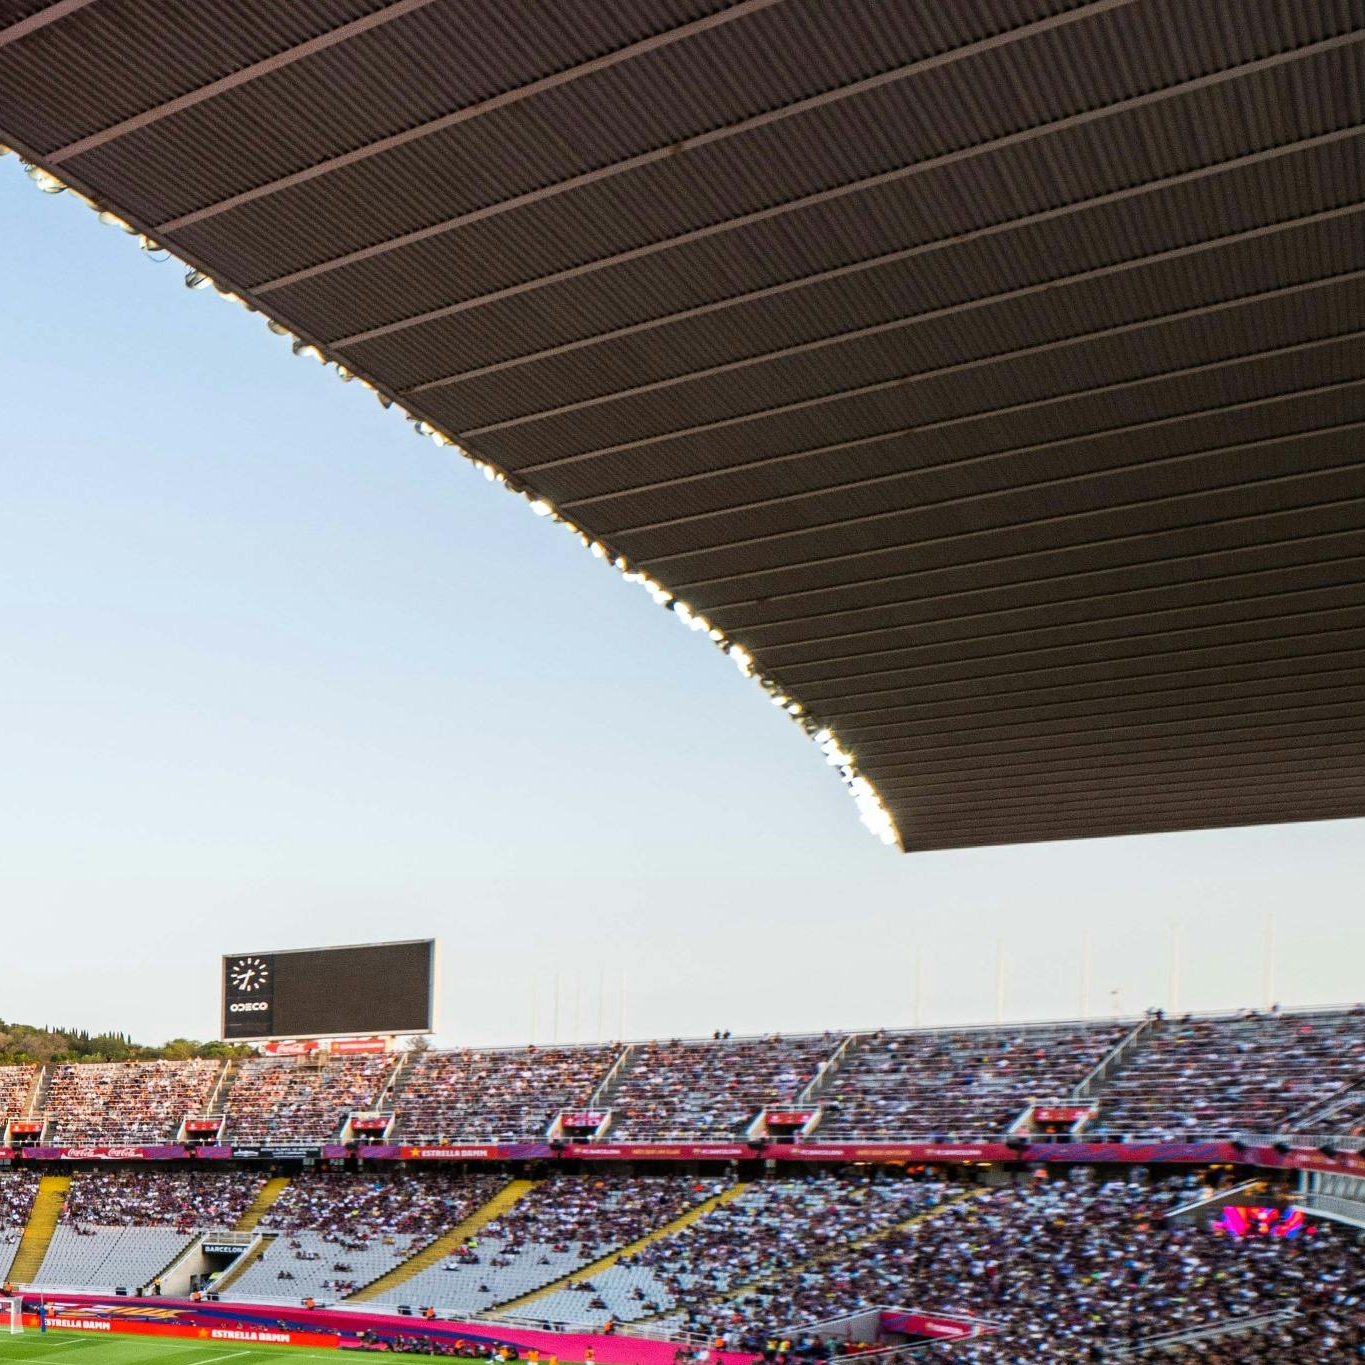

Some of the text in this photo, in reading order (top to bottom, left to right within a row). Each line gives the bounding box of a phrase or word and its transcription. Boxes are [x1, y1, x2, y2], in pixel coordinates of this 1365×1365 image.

[230, 1002, 268, 1013] ODECO
[421, 1149, 459, 1157] ESTRELLA
[205, 1246, 247, 1254] BARCELONA
[82, 1320, 110, 1330] DAMM
[211, 1329, 289, 1342] ESTRELLA DAMM
